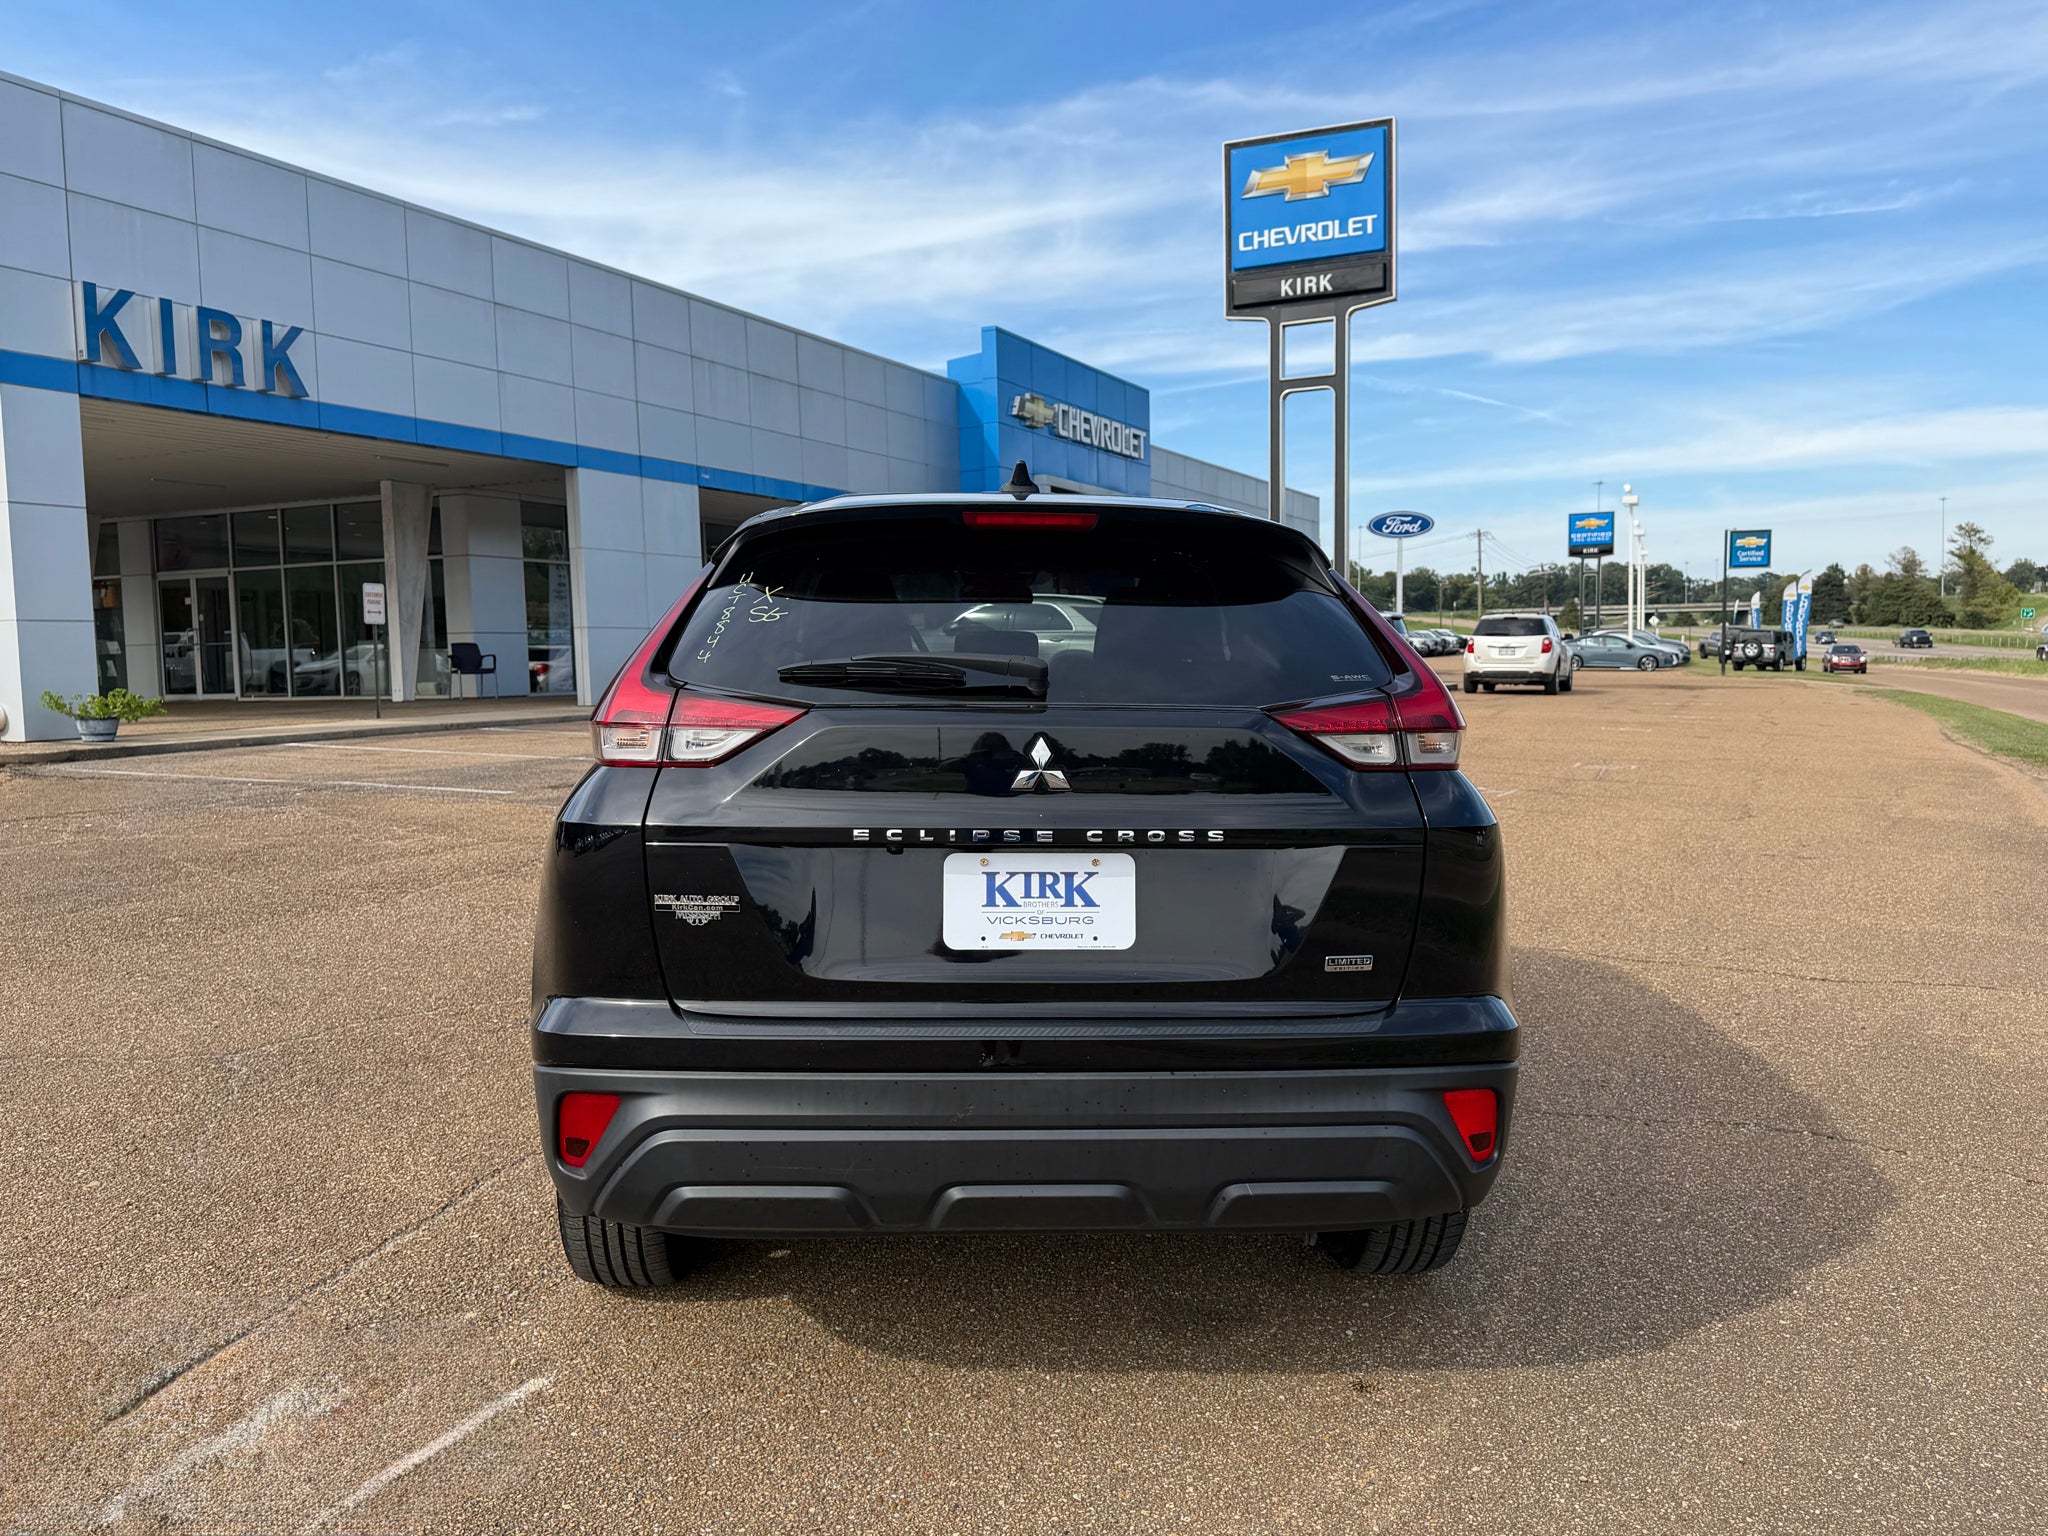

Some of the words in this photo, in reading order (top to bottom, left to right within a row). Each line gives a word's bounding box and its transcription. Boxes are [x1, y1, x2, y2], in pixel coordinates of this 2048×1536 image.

[1238, 214, 1378, 252] CHEVROLET
[1280, 273, 1333, 297] KIRK
[82, 280, 310, 398] KIRK
[1055, 402, 1147, 459] CHEVROLET
[1382, 516, 1422, 533] Ford
[852, 829, 1053, 842] ECLIPSE
[1086, 829, 1225, 842] CROSS
[654, 894, 678, 904] KIRK
[680, 895, 704, 904] AUTO
[706, 896, 740, 905] GROUP
[981, 871, 1101, 908] KIRK
[986, 916, 1095, 925] VICKSBURG
